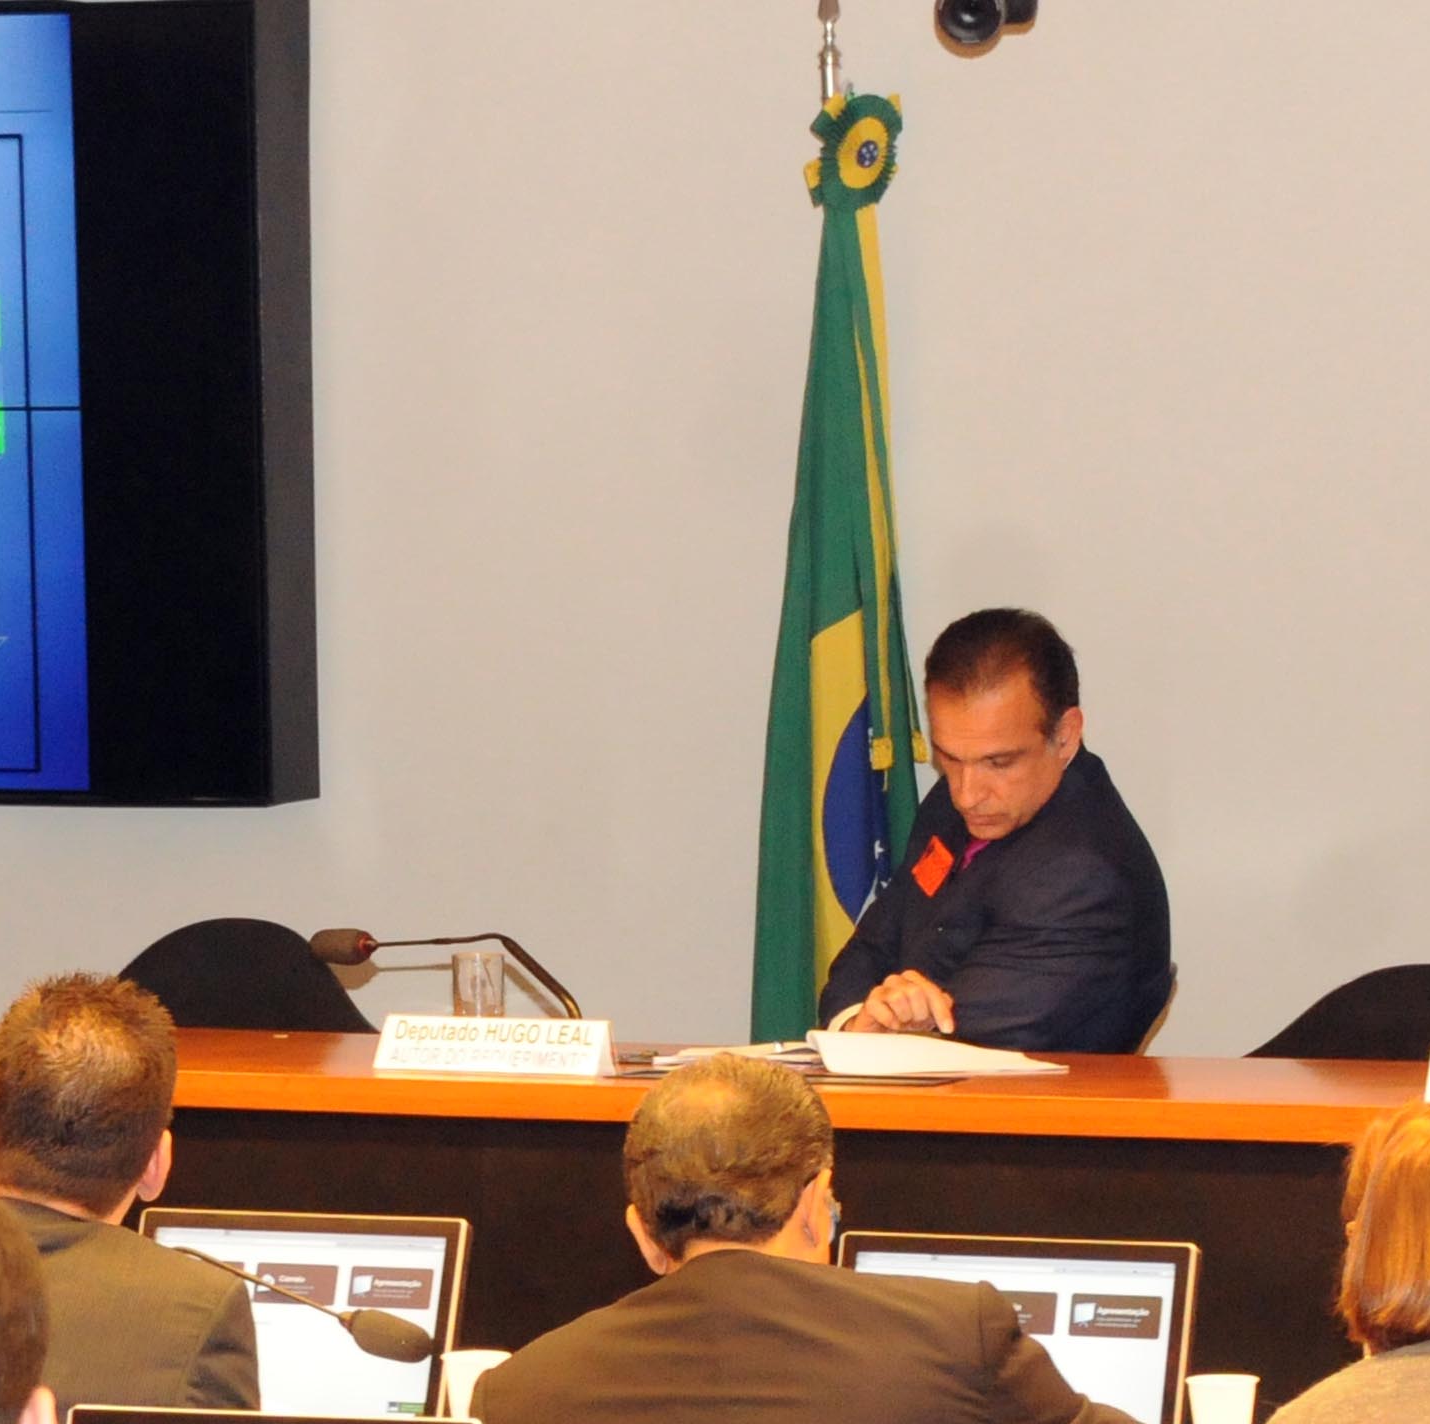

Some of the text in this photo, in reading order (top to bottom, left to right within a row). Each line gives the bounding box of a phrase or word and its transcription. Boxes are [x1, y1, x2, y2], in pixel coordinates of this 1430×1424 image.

[395, 1019, 592, 1046] Deputado HUGO LEAL
